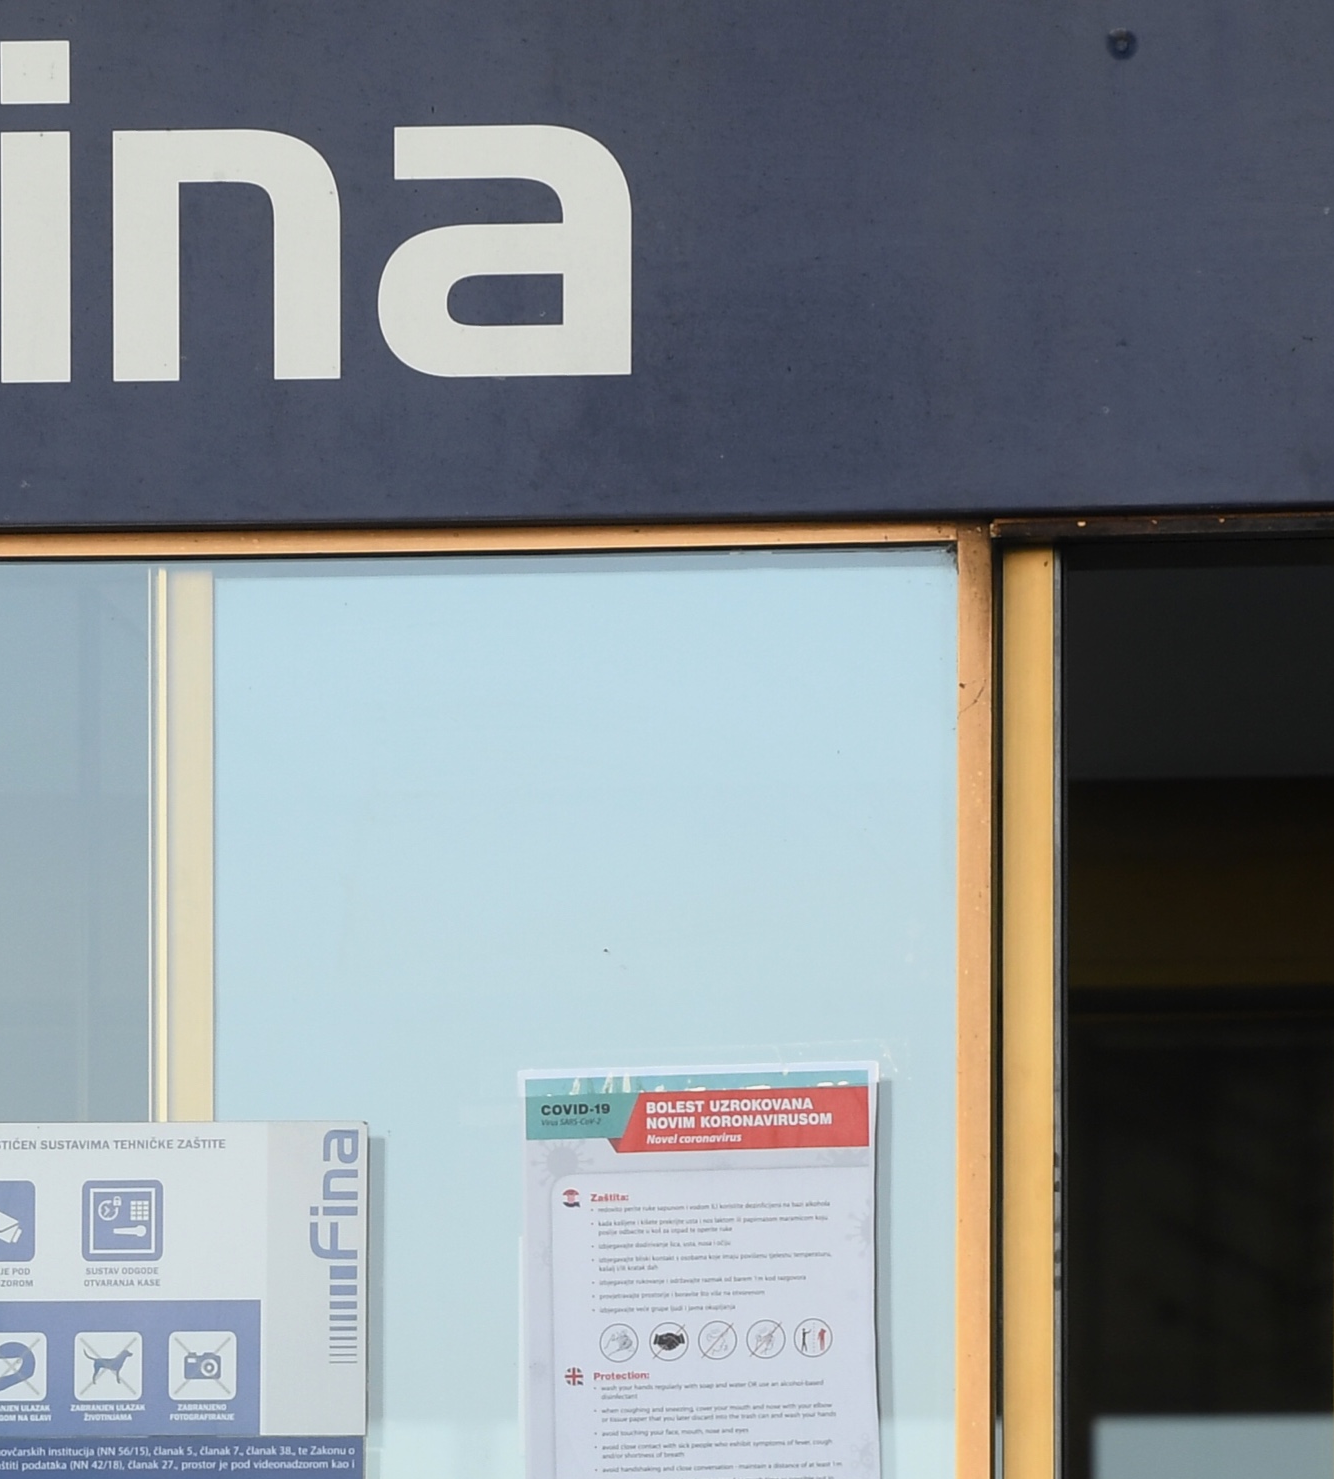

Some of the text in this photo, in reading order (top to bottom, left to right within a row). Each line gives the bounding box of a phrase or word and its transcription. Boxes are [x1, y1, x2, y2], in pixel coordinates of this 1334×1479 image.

[541, 1103, 610, 1116] COVID-19
[646, 1097, 813, 1114] BOLEST UZROKOVANA
[646, 1112, 832, 1129] NOVIM KORONAVIRUSOM
[39, 1139, 109, 1150] SUSTAVIMA
[112, 1136, 173, 1149] TEHNIČKE
[176, 1136, 225, 1149] ZAŠTITE
[646, 1131, 742, 1144] Novel coronavirus
[309, 1129, 359, 1260] Fina
[590, 1192, 628, 1202] Zaštita:
[0, 1267, 9, 1275] JE
[11, 1267, 30, 1275] POD
[85, 1266, 159, 1275] SUSTAV ODGODE
[83, 1278, 160, 1287] OTVARANJA KASE
[593, 1370, 649, 1381] Protection:
[48, 1447, 94, 1458] institucija
[96, 1446, 116, 1457] (NN
[153, 1445, 184, 1456] članak
[199, 1445, 230, 1455] članak
[245, 1445, 277, 1455] članak
[297, 1446, 308, 1455] te
[309, 1445, 346, 1455] Zakonu
[348, 1447, 355, 1455] o
[21, 1460, 67, 1471] podataka
[69, 1460, 88, 1470] (NN
[127, 1459, 158, 1469] članak
[181, 1460, 216, 1471] prostor
[218, 1459, 228, 1471] je
[230, 1459, 250, 1471] pod
[253, 1459, 328, 1469] videonadzorom
[331, 1458, 349, 1468] kao
[351, 1459, 355, 1468] i
